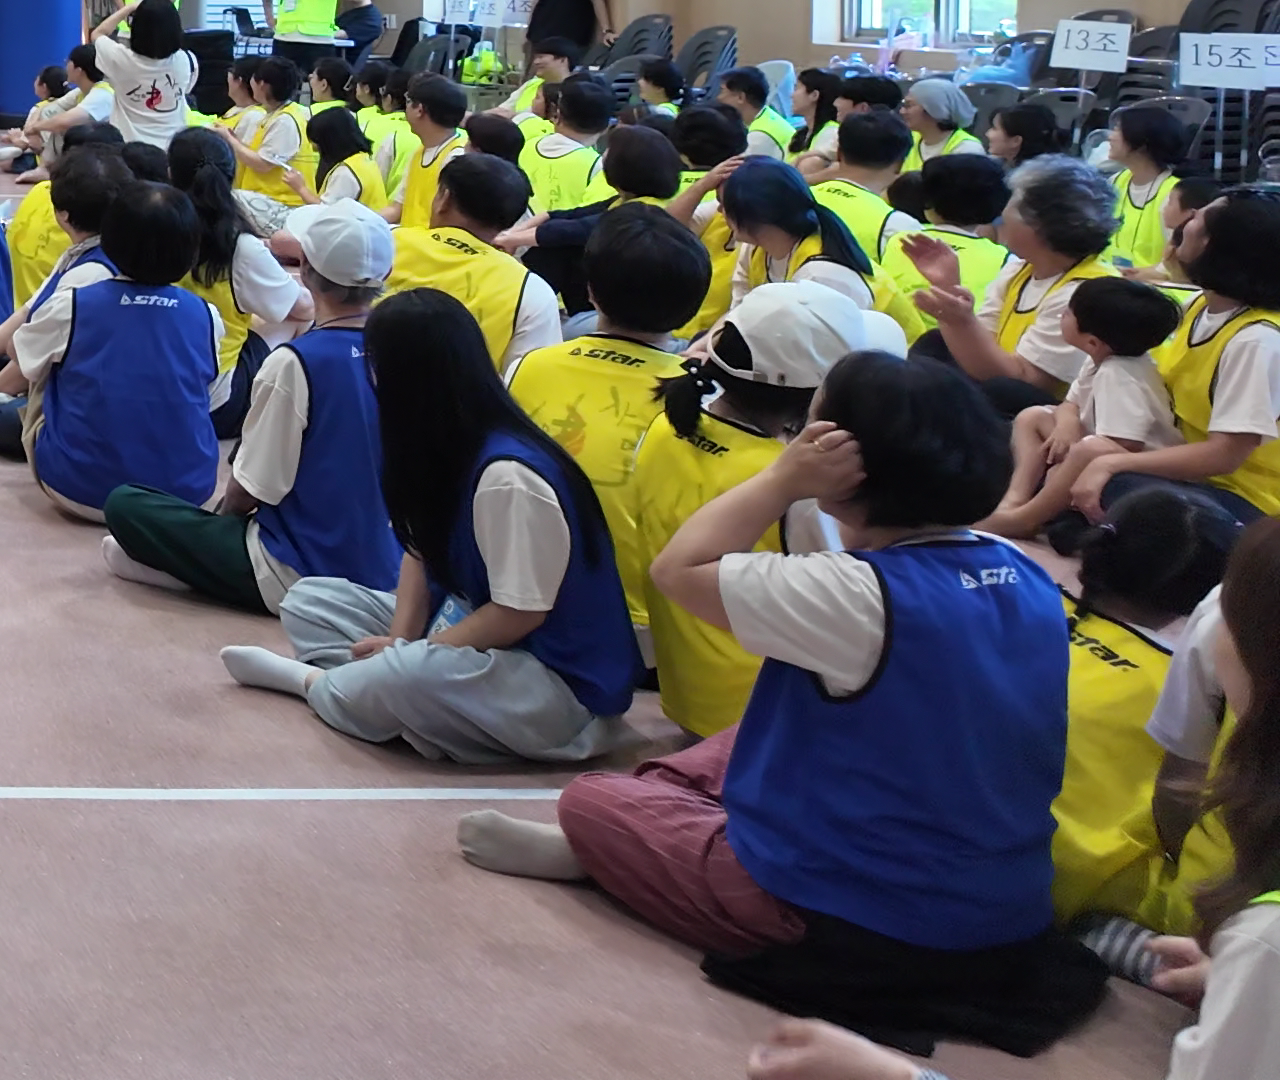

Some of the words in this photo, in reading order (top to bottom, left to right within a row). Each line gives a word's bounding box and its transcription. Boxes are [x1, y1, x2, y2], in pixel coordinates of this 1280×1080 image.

[506, 0, 533, 13] 4조
[1063, 28, 1120, 53] 13조
[1192, 43, 1257, 69] 15조
[584, 348, 646, 368] star
[980, 565, 1020, 585] sta
